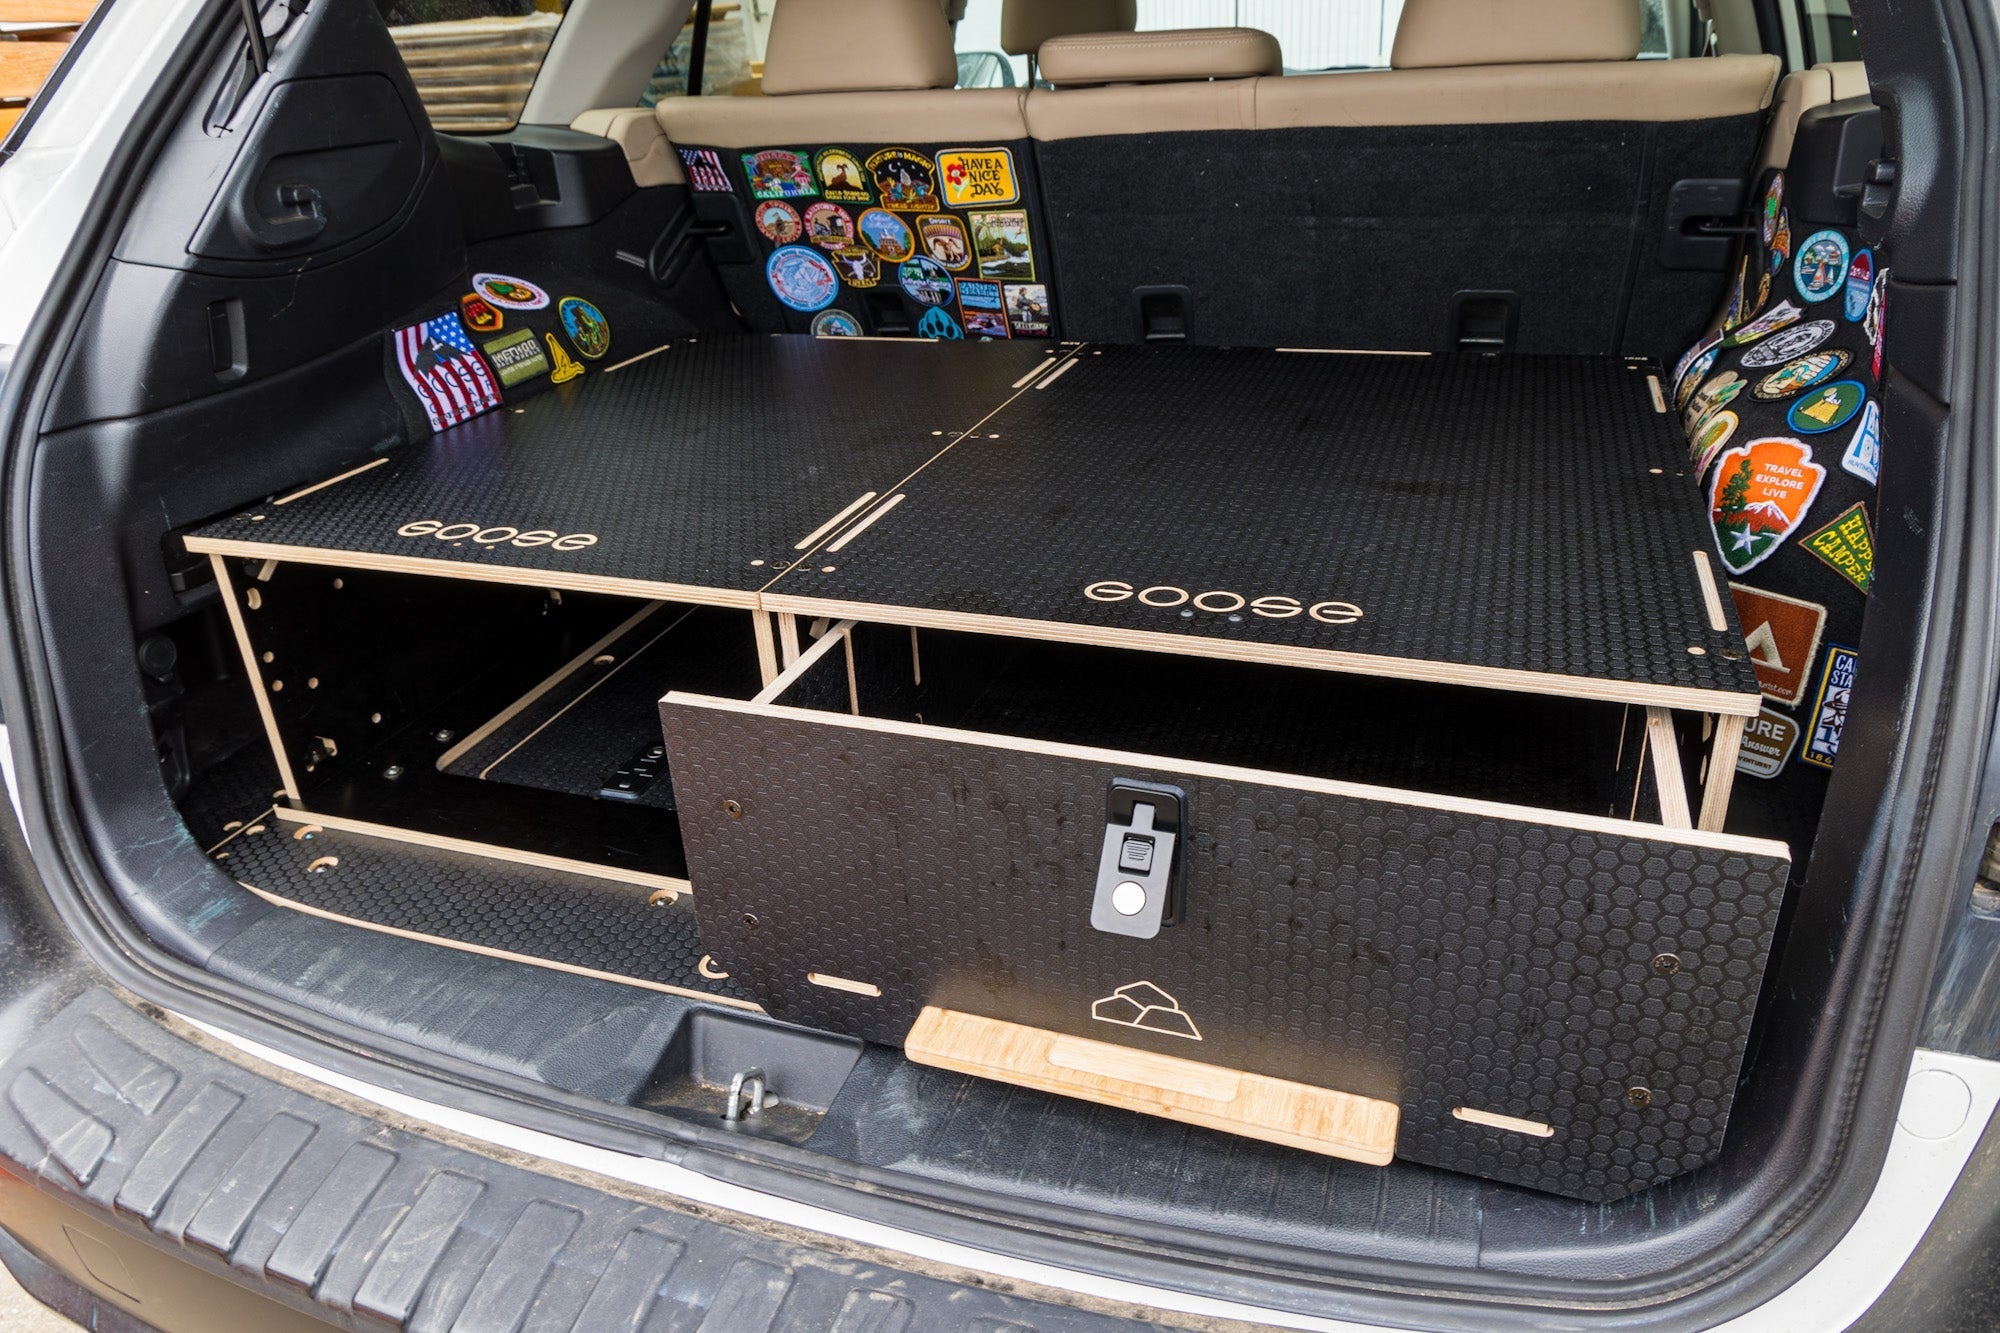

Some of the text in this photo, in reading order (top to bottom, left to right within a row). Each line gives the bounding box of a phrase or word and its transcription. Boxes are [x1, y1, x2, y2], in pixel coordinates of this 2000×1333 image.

[868, 151, 897, 169] NATURE
[903, 152, 931, 169] MAGIC
[959, 157, 1003, 170] HAVE A
[968, 170, 1001, 182] NICE
[757, 188, 815, 199] CALIFORNIA
[971, 182, 1004, 198] DAY
[491, 339, 537, 365] METHOD
[429, 381, 493, 414] GAR
[1764, 463, 1804, 478] TRAVEL
[1755, 474, 1805, 490] EXPLORE
[1762, 487, 1788, 499] LIVE
[1813, 530, 1867, 583] CAMPER
[1835, 654, 1856, 673] CA
[1830, 669, 1853, 688] STA
[1759, 681, 1793, 697] turist.com
[1744, 717, 1786, 741] URE
[1741, 735, 1781, 757] Answer
[1810, 751, 1832, 764] 186
